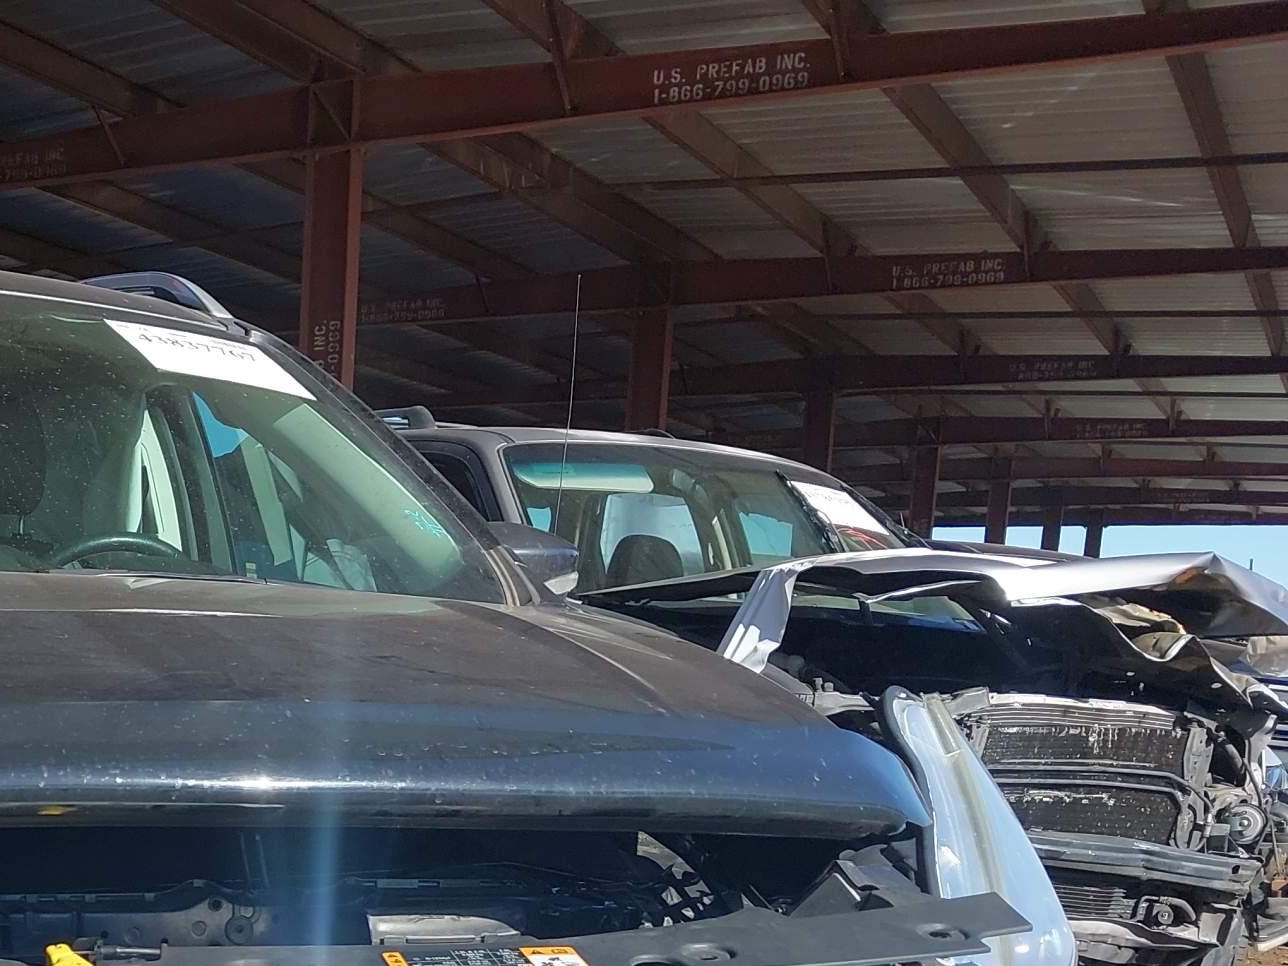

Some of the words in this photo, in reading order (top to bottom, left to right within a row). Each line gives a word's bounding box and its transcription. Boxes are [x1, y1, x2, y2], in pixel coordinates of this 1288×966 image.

[653, 68, 686, 85] U.S.
[696, 57, 766, 80] PREFAB
[776, 52, 811, 70] INC.
[653, 72, 809, 104] 1-866-799-0969
[892, 271, 1005, 289] 1866-799-0969
[314, 319, 327, 351] INC.
